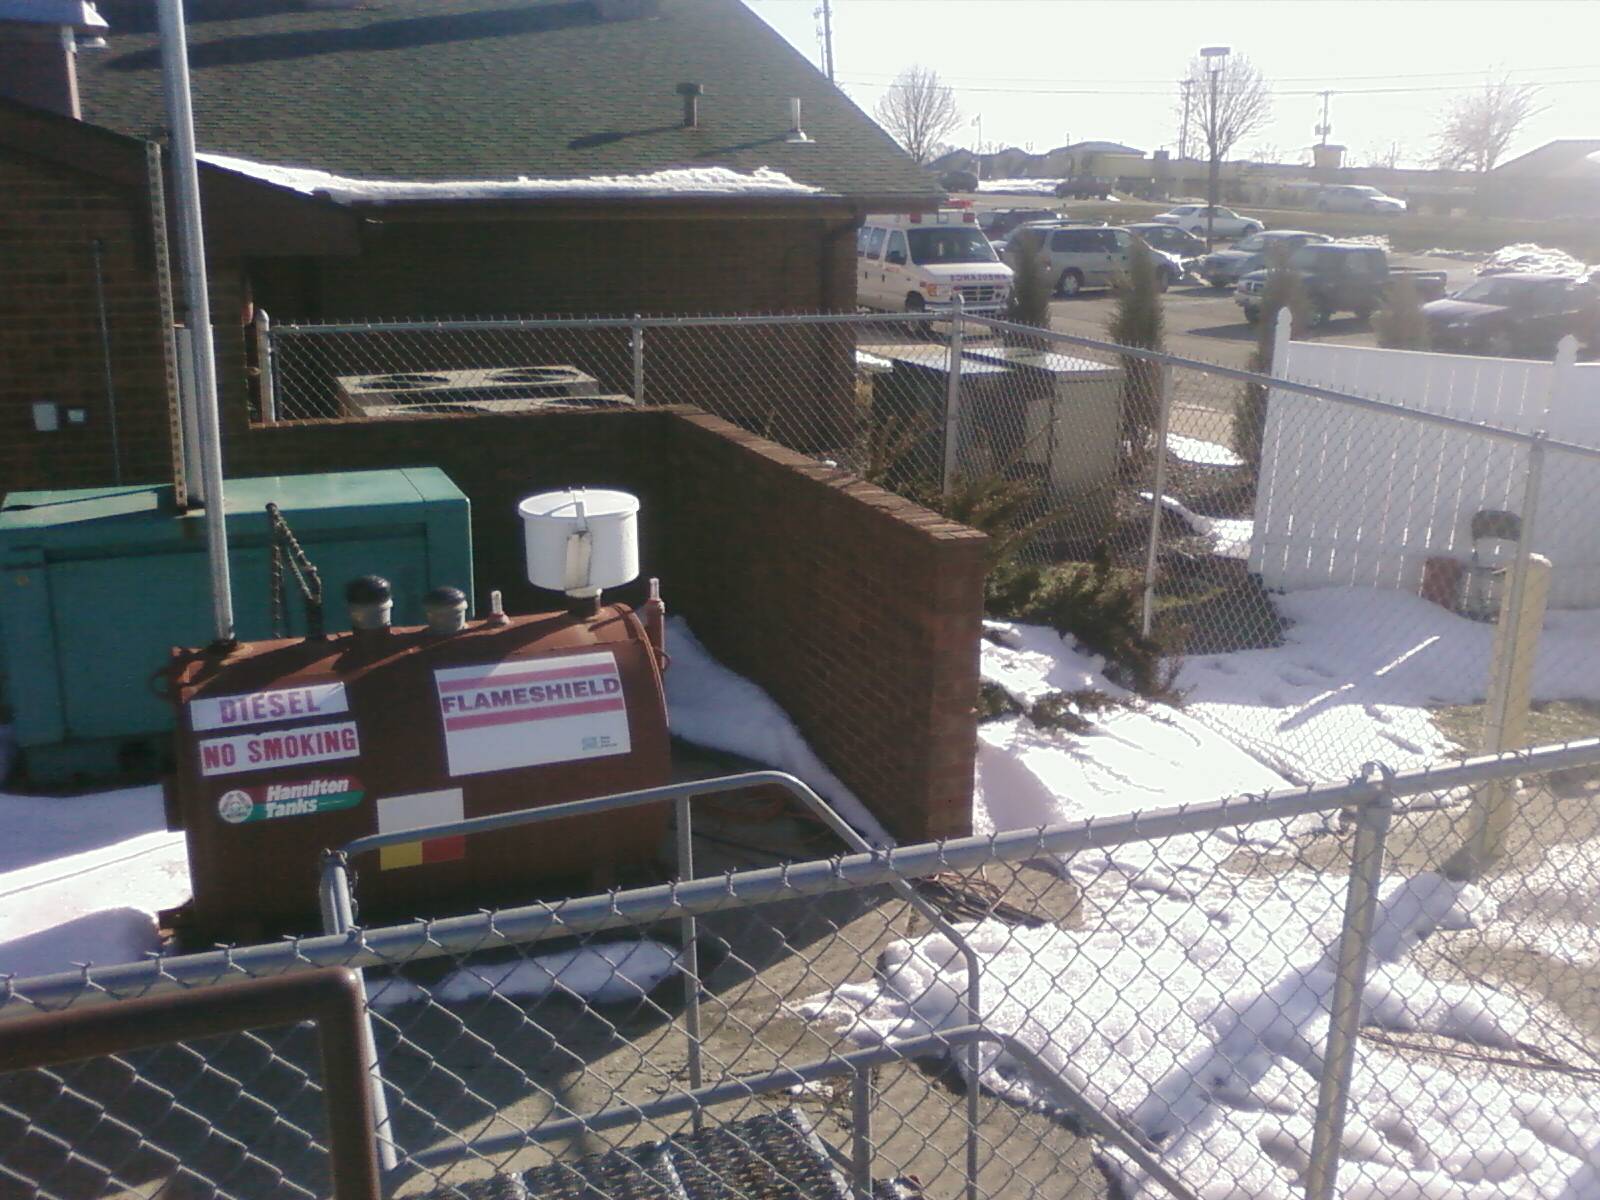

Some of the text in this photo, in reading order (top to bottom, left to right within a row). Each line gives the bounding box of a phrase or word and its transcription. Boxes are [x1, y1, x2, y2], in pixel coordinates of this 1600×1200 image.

[219, 690, 321, 724] DIESEL
[441, 677, 620, 714] FLAMESHIELD
[203, 728, 357, 769] NO SMOKING
[266, 779, 350, 802] Hamilton
[266, 799, 318, 818] Tanks
